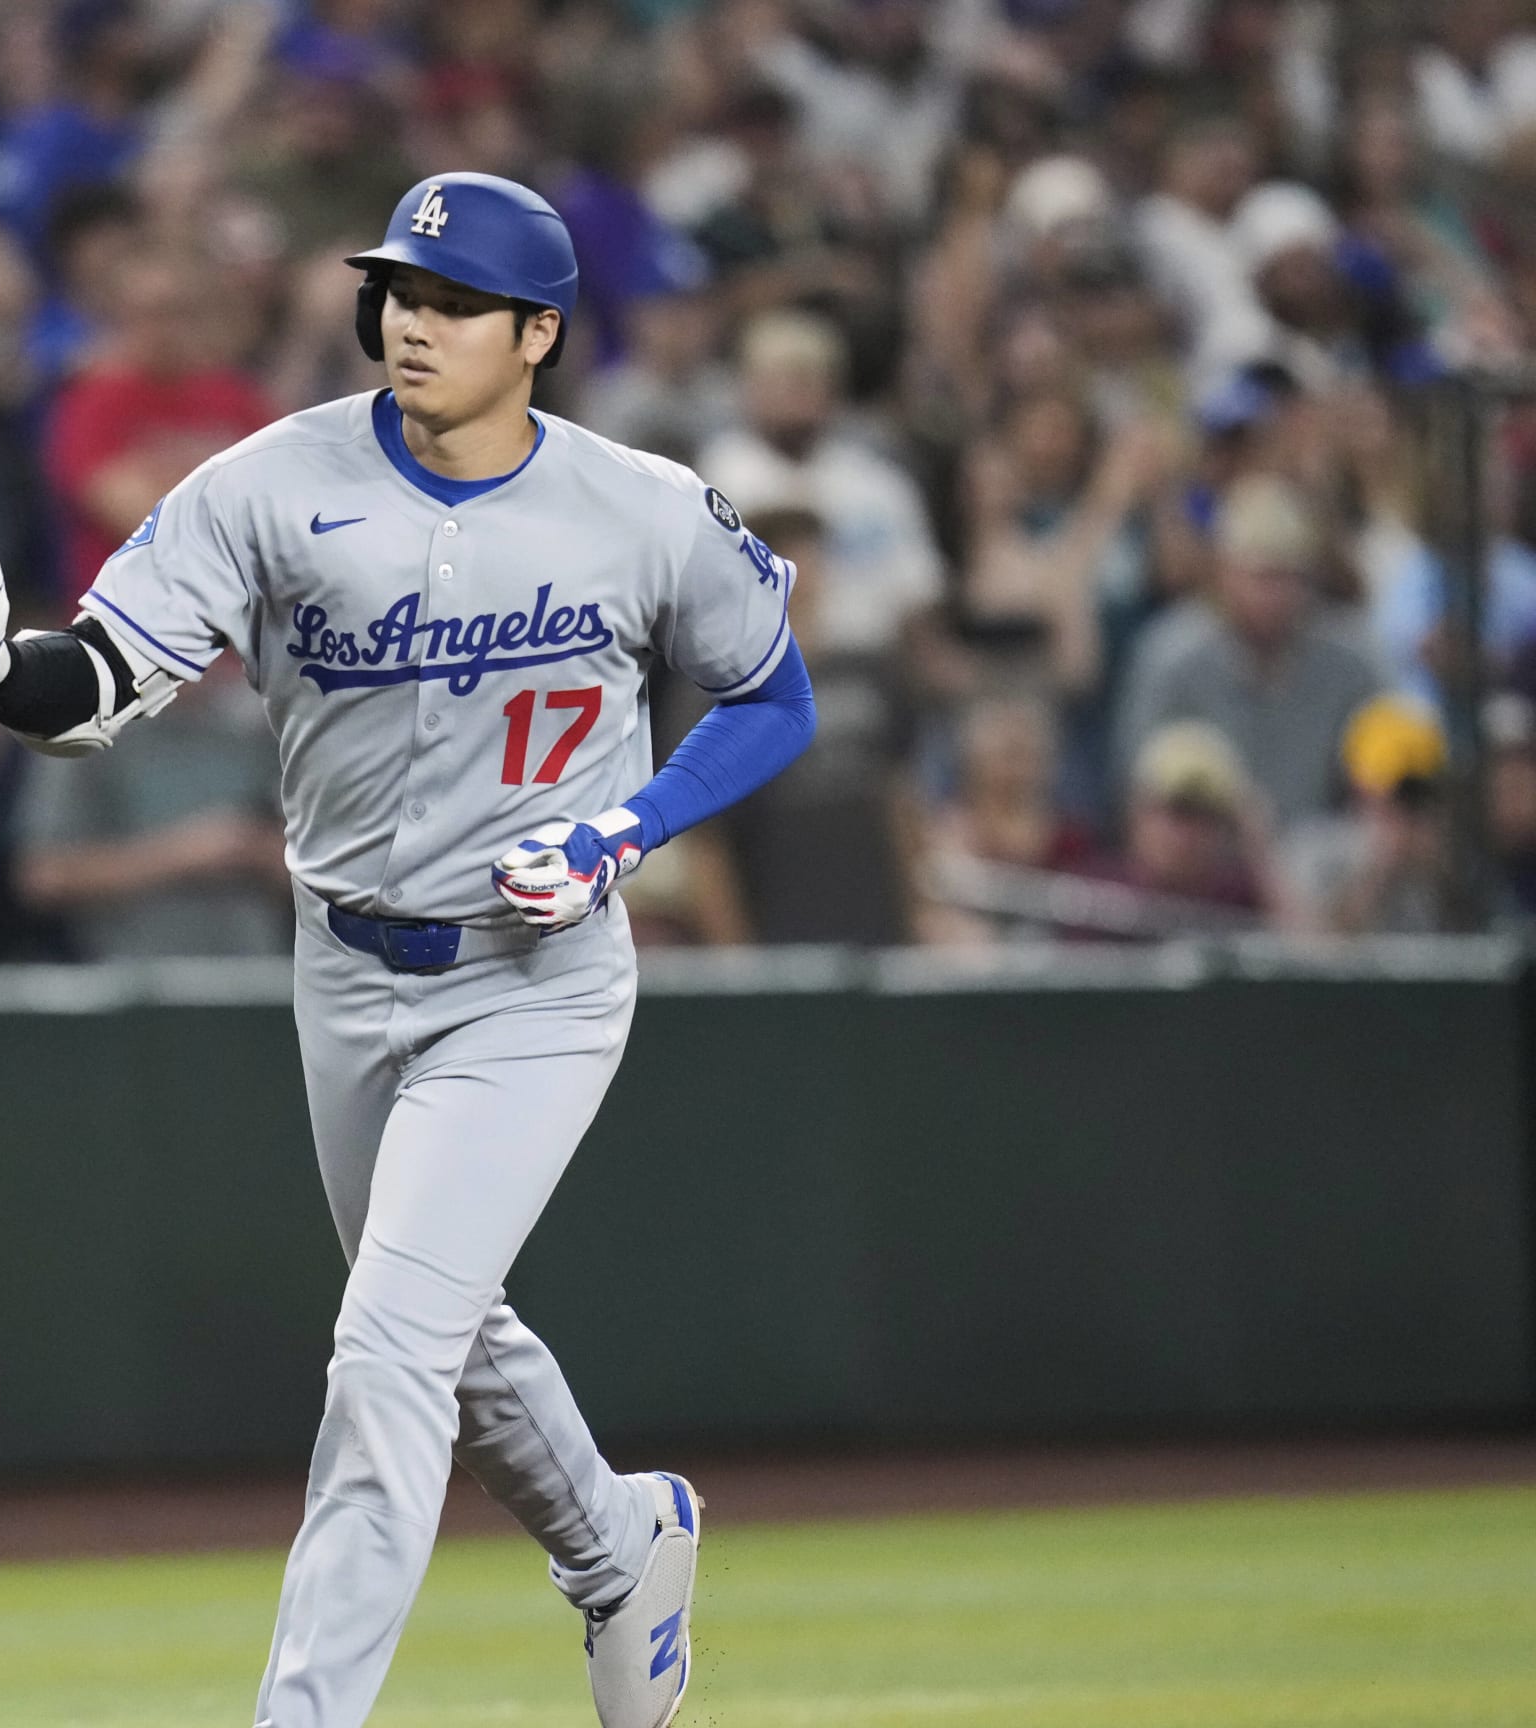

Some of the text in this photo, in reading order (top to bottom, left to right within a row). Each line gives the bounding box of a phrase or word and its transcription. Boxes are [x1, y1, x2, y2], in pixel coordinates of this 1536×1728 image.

[411, 184, 449, 238] LA
[287, 582, 614, 697] Los Angeles
[501, 685, 603, 786] 17
[511, 880, 570, 891] new balance
